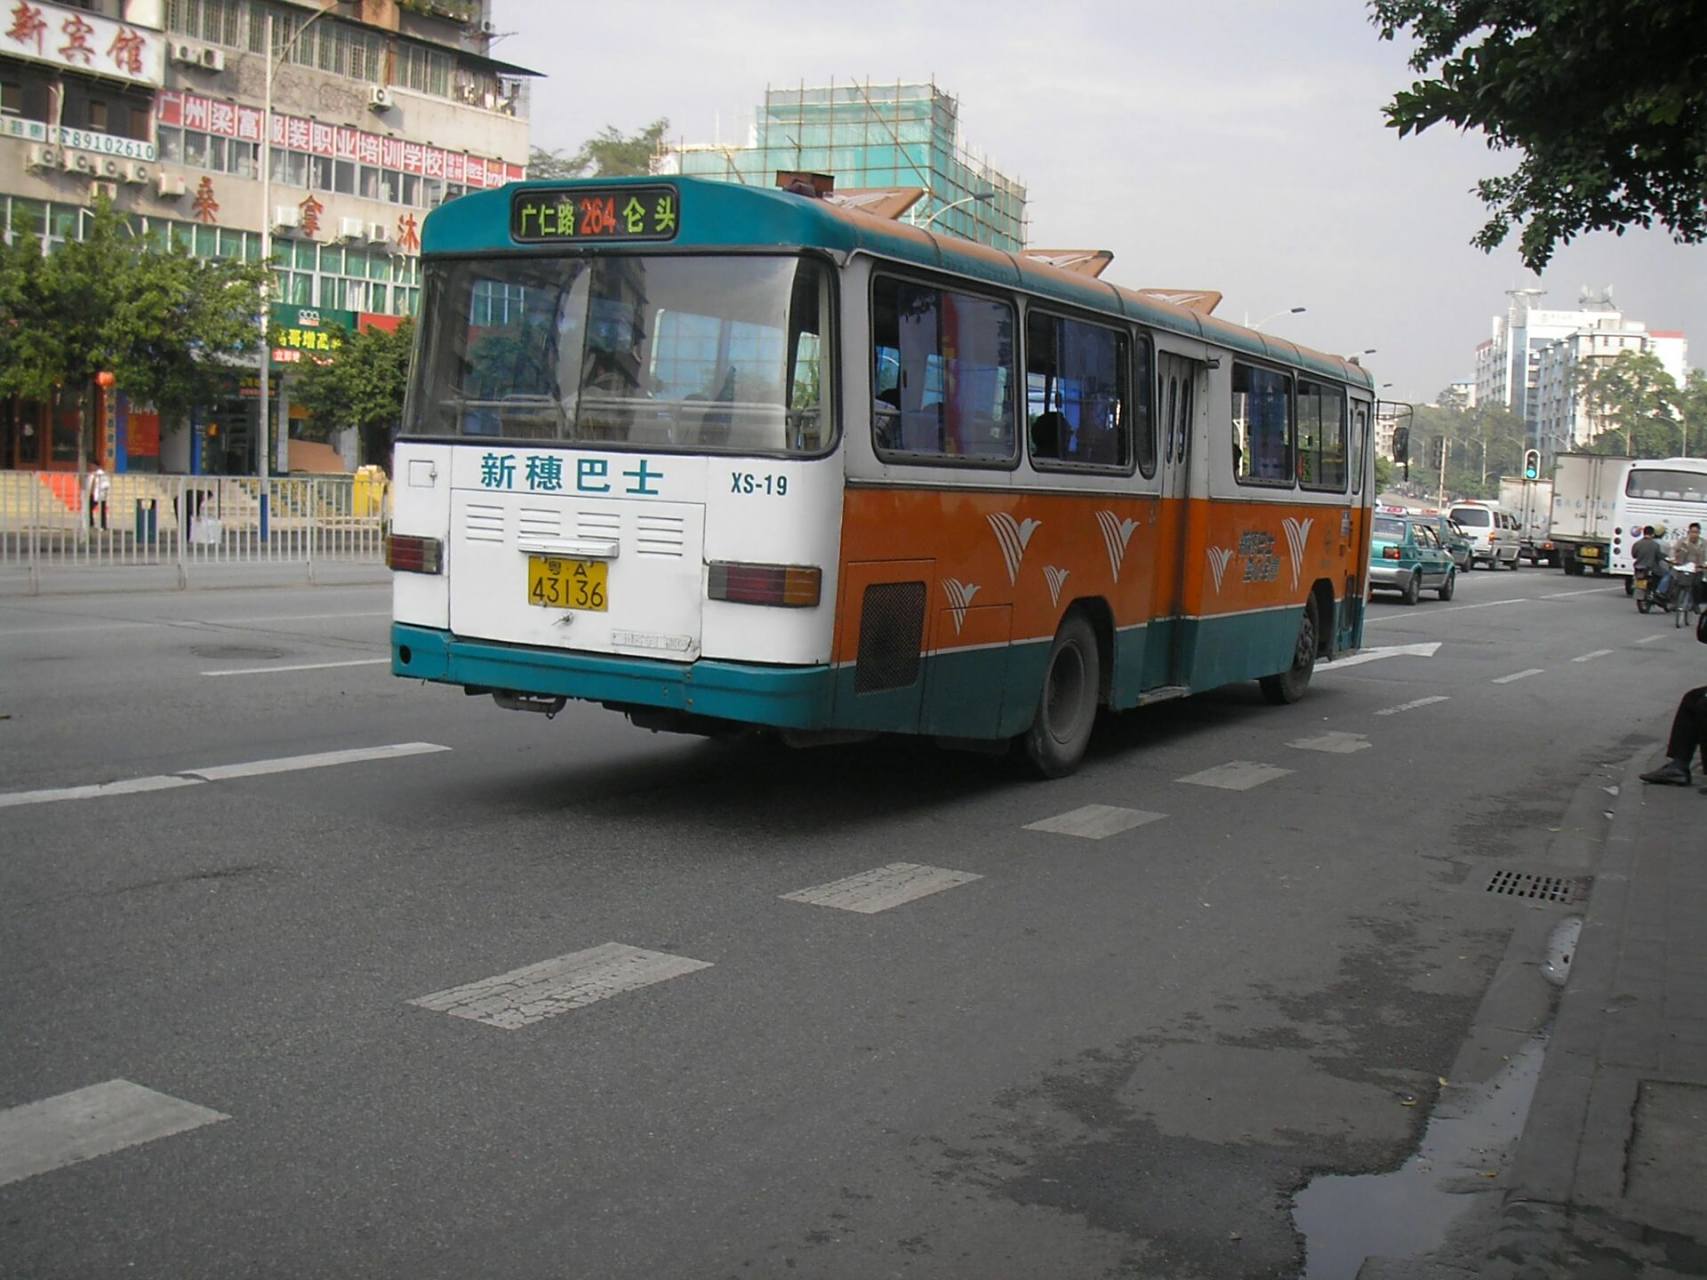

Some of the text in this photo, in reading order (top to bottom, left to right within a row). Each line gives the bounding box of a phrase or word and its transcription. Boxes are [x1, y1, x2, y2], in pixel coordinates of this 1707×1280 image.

[5, 1, 147, 75] 新宾馆
[73, 131, 155, 160] 89102610
[158, 92, 443, 178] 广州梁富服装职业培训学校
[521, 203, 575, 236] 广仁路
[623, 196, 676, 234] 仑头
[481, 453, 787, 496] 新穗巴士 XS-19
[533, 576, 604, 607] 43136
